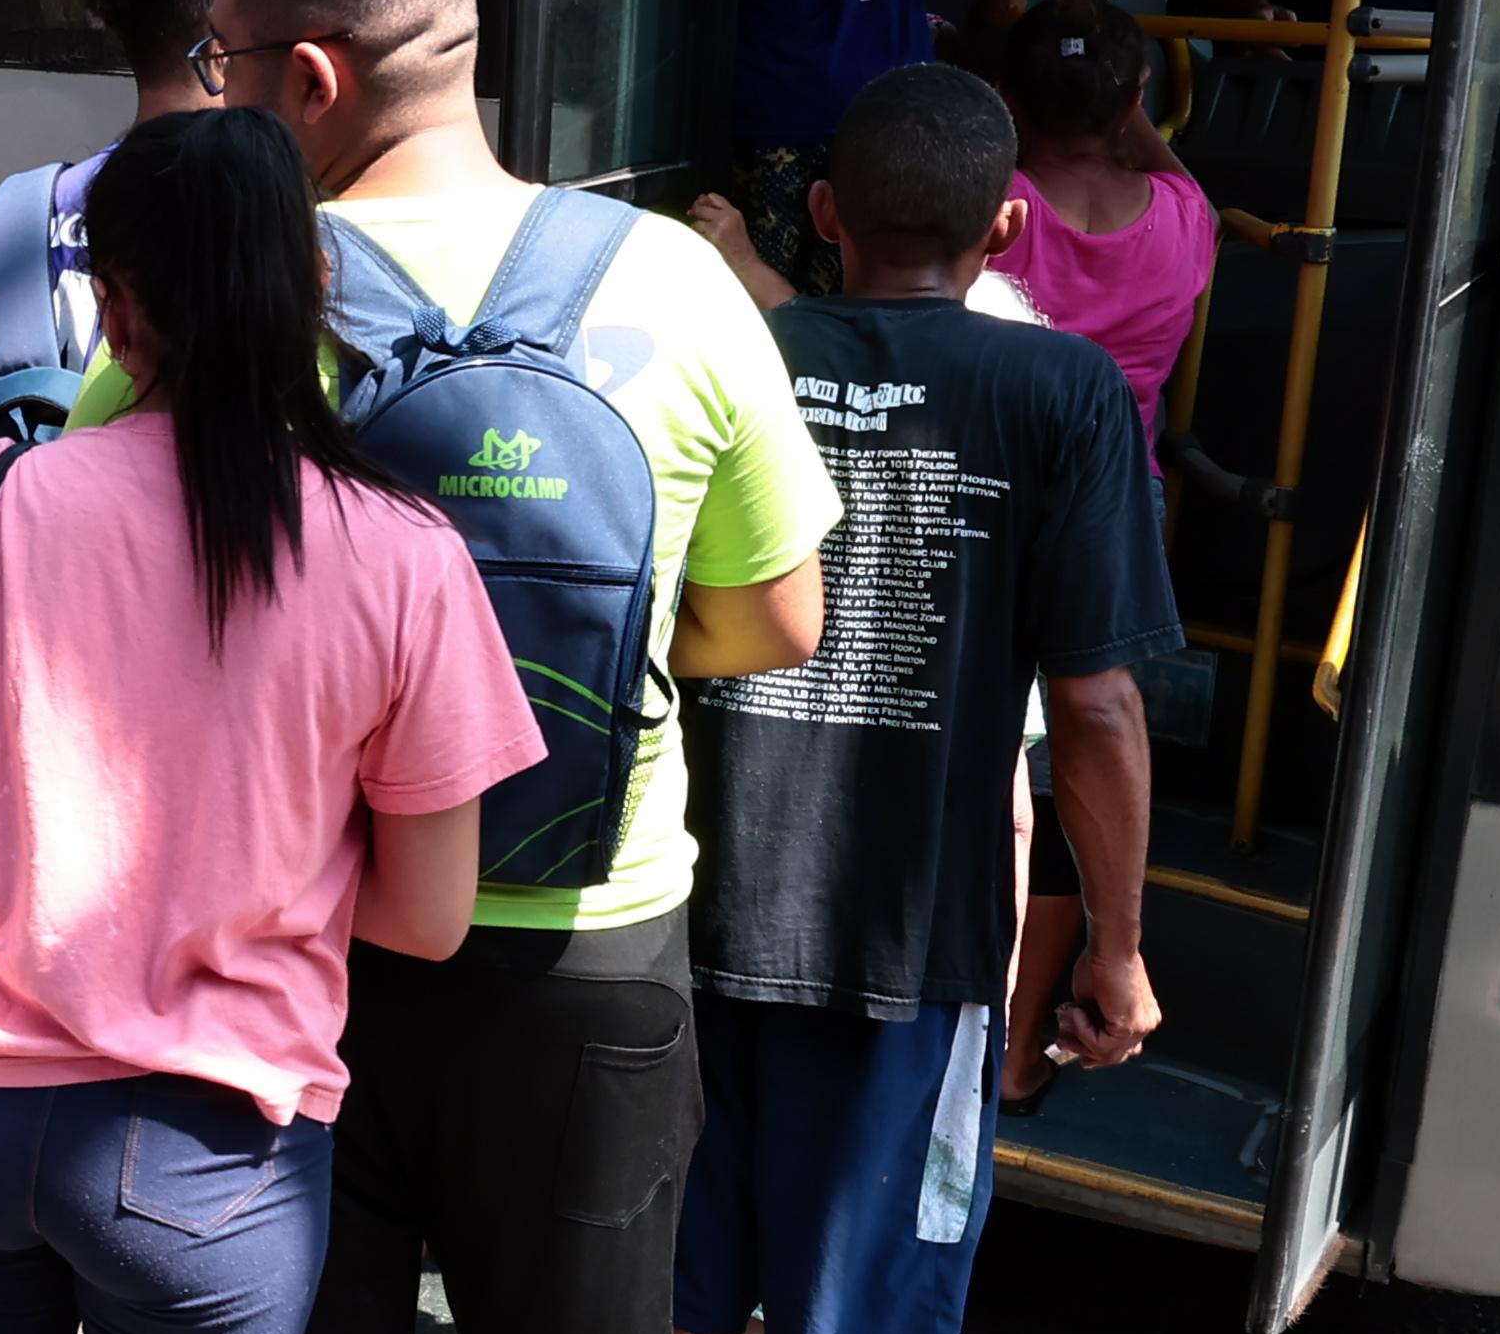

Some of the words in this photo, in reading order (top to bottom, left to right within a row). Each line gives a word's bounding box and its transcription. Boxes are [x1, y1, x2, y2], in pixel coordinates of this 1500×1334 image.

[911, 448, 957, 460] THEATRE
[438, 475, 569, 500] MICROCAMP
[957, 484, 1001, 498] FESTIVAL
[925, 493, 951, 503] HALL
[930, 548, 956, 558] HALL
[920, 558, 948, 568] CLUB
[905, 569, 932, 578] CLUB
